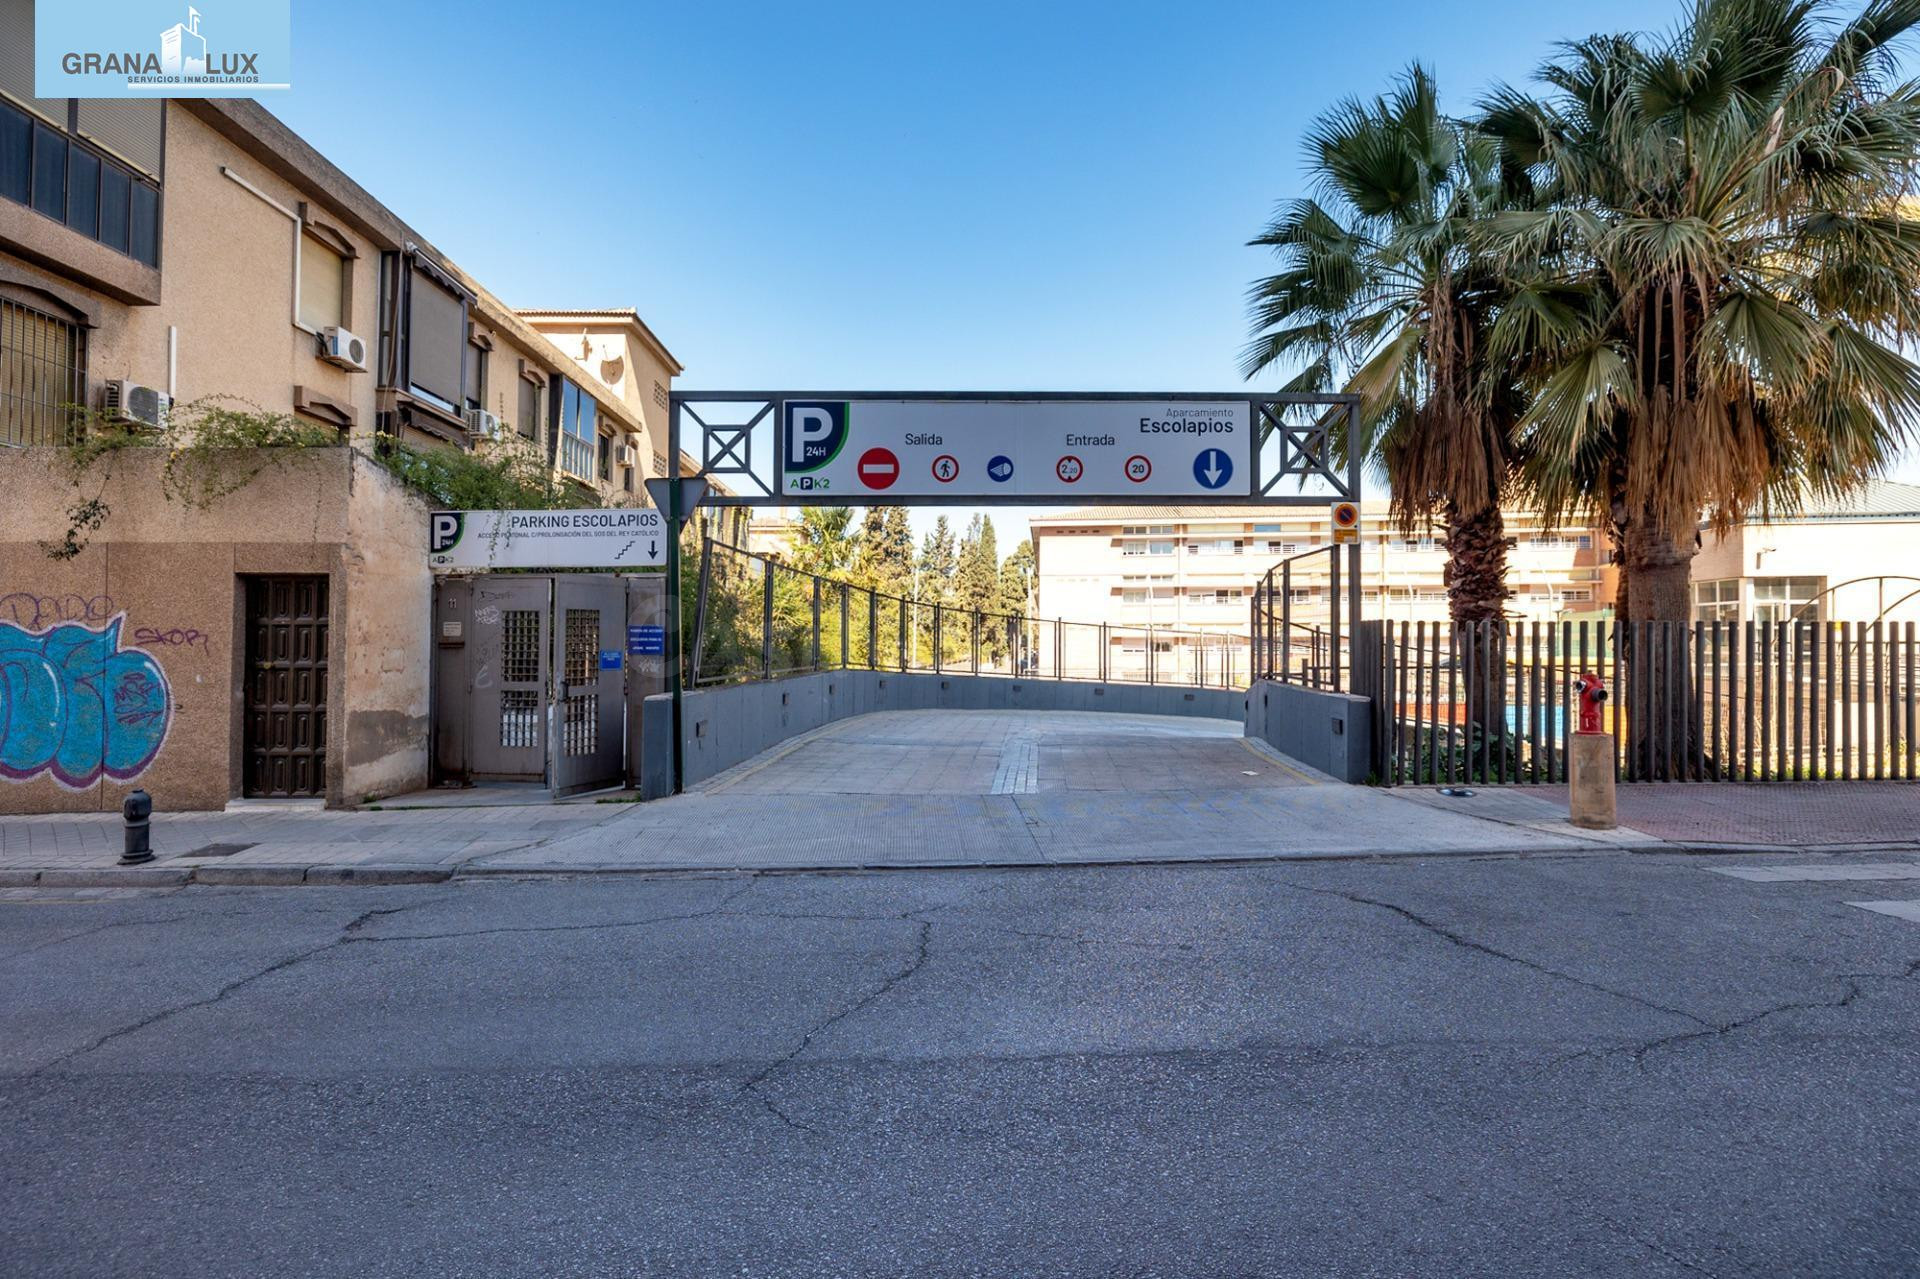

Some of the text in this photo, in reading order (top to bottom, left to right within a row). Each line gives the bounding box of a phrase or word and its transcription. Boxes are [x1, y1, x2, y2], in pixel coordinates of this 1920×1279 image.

[1165, 408, 1234, 418] Aparcamiento
[1139, 418, 1234, 436] Escolapios
[792, 407, 834, 463] P
[904, 433, 943, 446] Salida
[1065, 434, 1116, 447] Entrada
[806, 446, 827, 457] 24H
[1132, 464, 1145, 474] 20
[511, 514, 659, 528] PARKING ESCOLAPIOS
[433, 515, 458, 550] P
